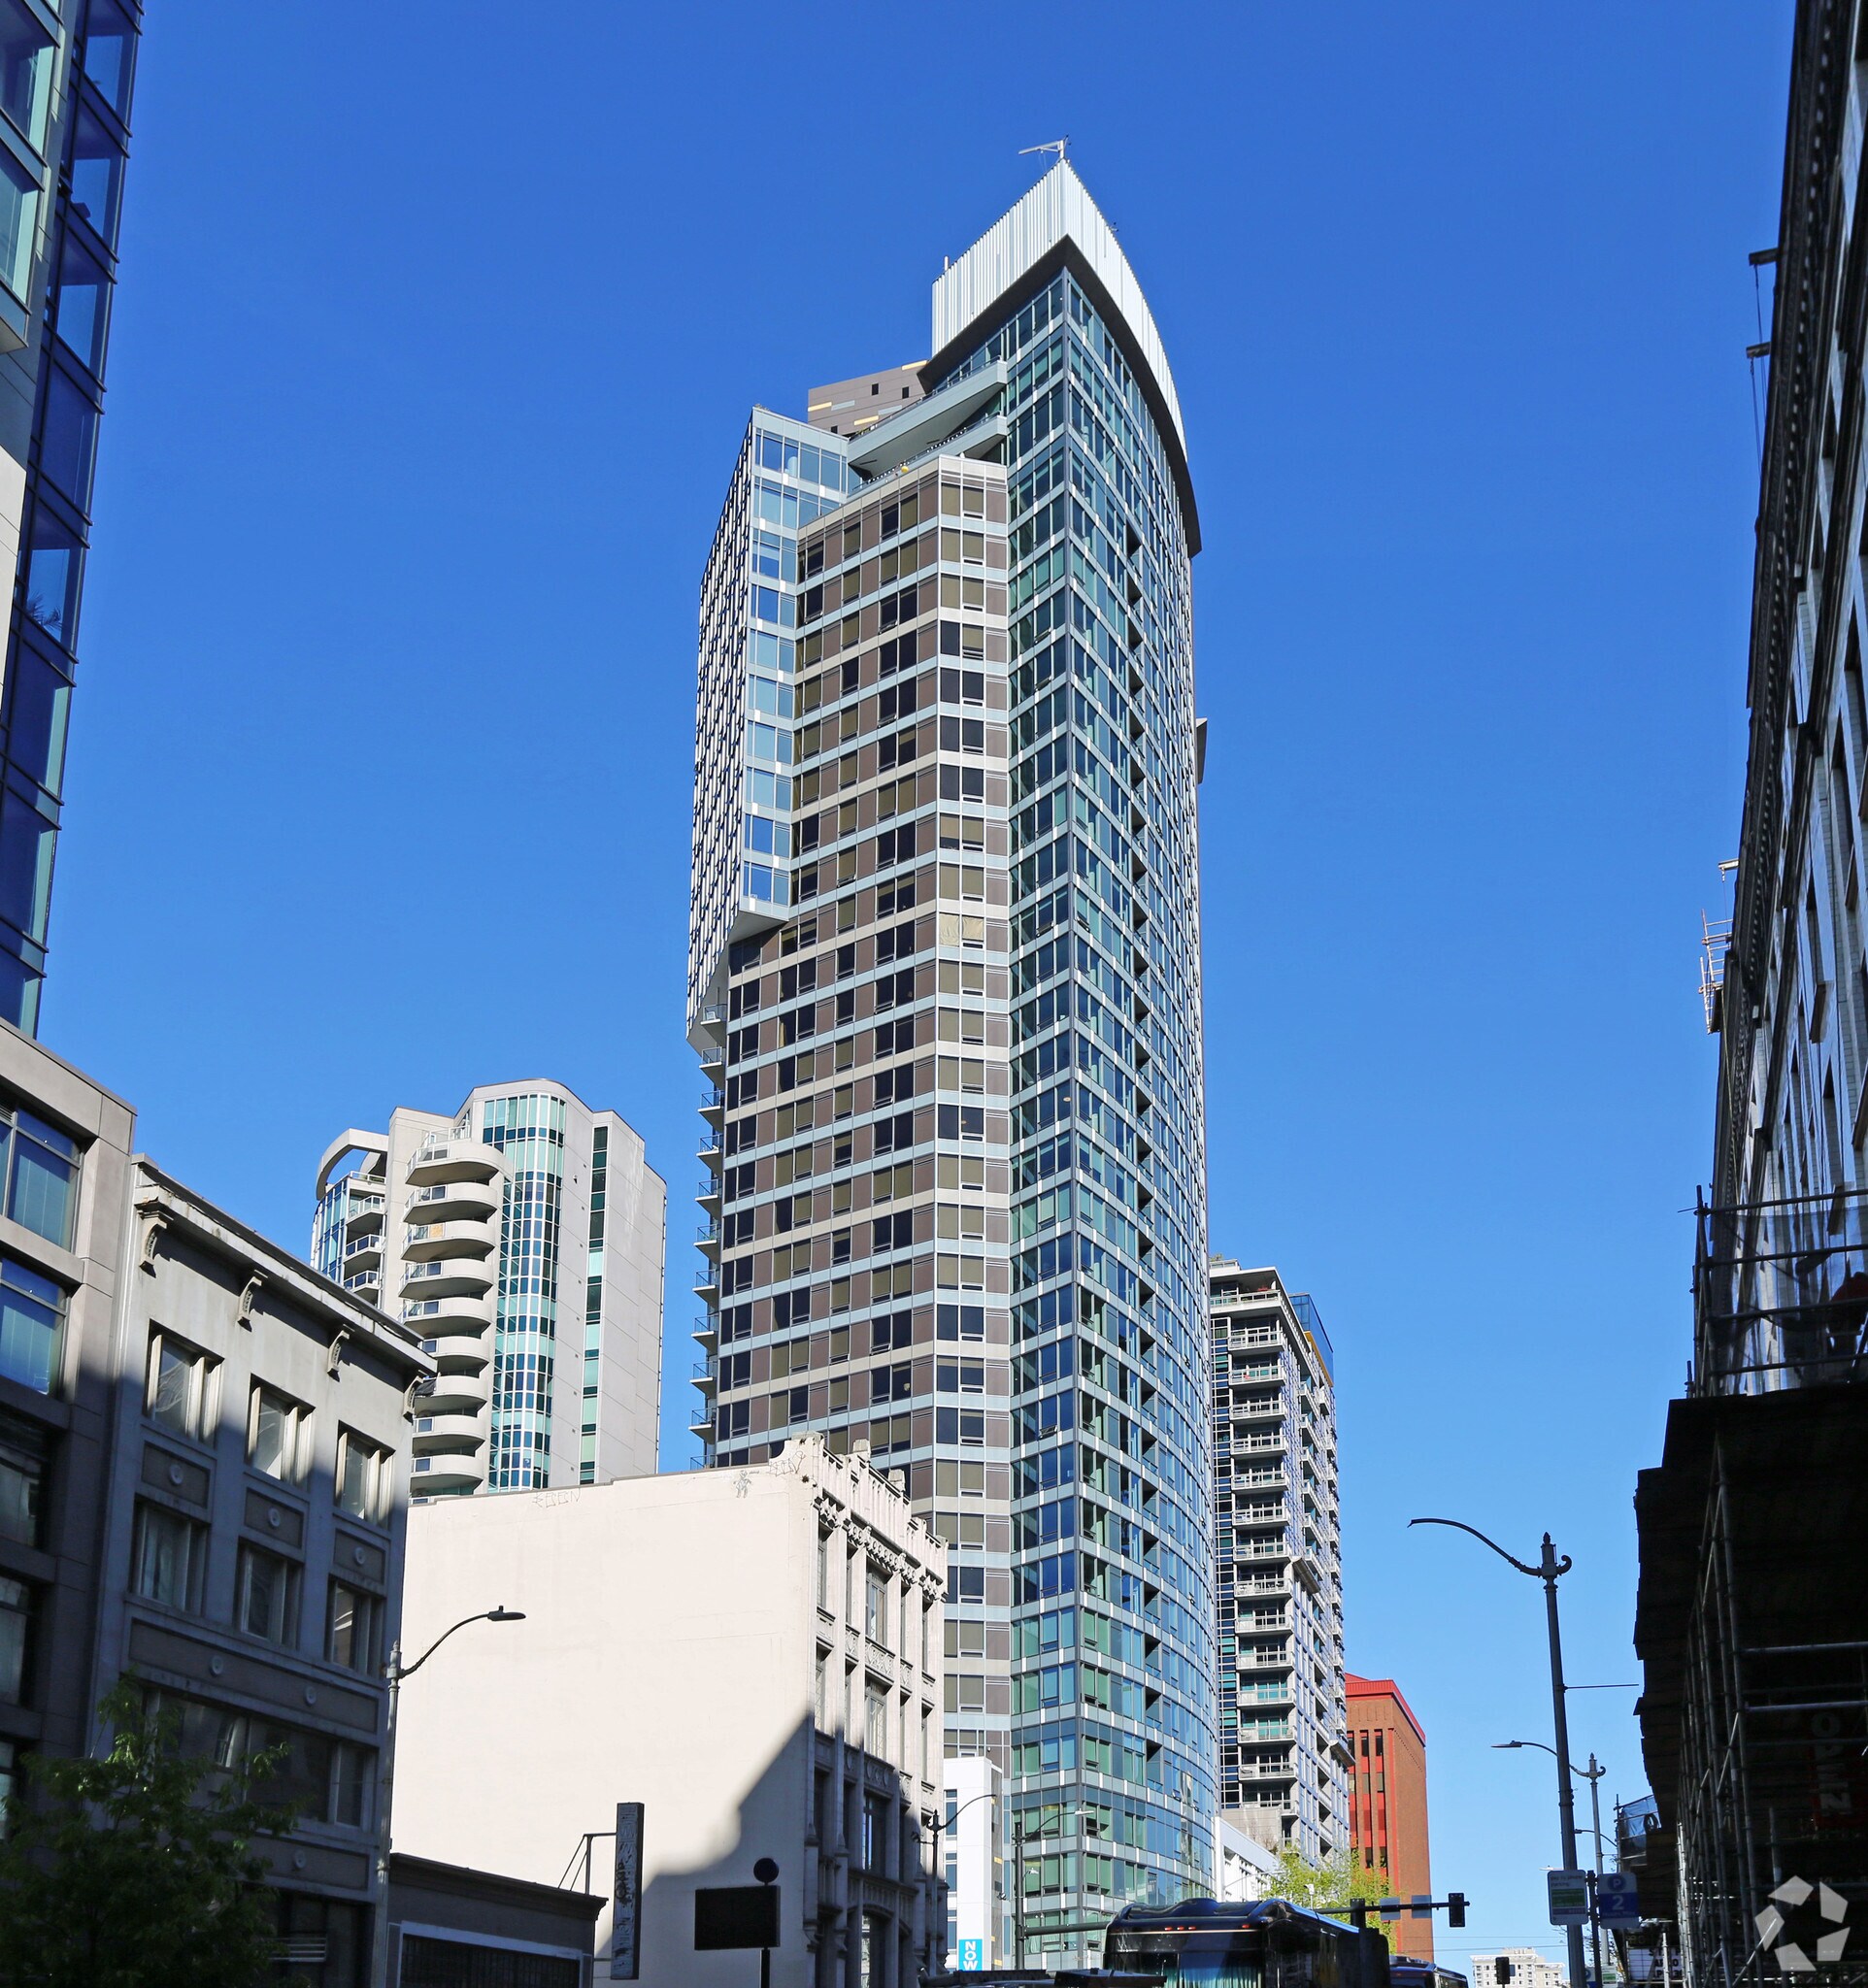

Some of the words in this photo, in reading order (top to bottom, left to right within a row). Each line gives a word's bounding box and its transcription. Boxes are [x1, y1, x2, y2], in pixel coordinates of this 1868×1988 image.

[1613, 1878, 1622, 1889] P
[1612, 1895, 1624, 1910] 2
[963, 1940, 979, 1971] NOW
